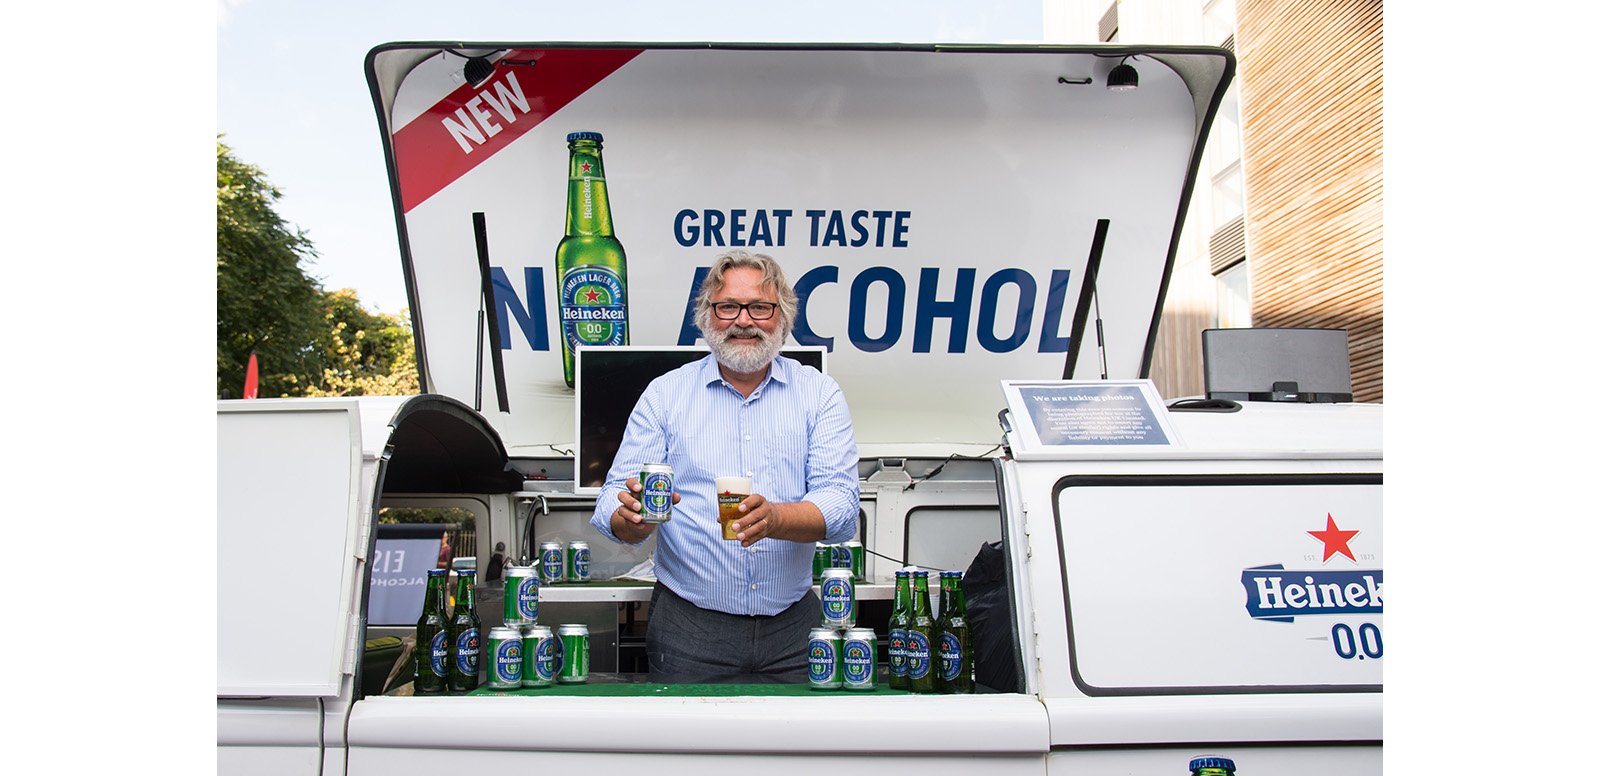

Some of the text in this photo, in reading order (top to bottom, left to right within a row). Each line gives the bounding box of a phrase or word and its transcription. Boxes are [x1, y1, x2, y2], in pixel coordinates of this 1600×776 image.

[441, 70, 531, 154] NEW
[582, 176, 592, 219] Heineken
[673, 208, 912, 248] GREAT TASTE
[588, 274, 612, 286] LAGER
[610, 282, 622, 299] BEER
[563, 307, 625, 320] Heineken
[586, 323, 602, 334] 0.0
[677, 265, 1071, 354] ACOHOL
[1100, 394, 1135, 402] photos
[1331, 622, 1383, 660] 0.0
